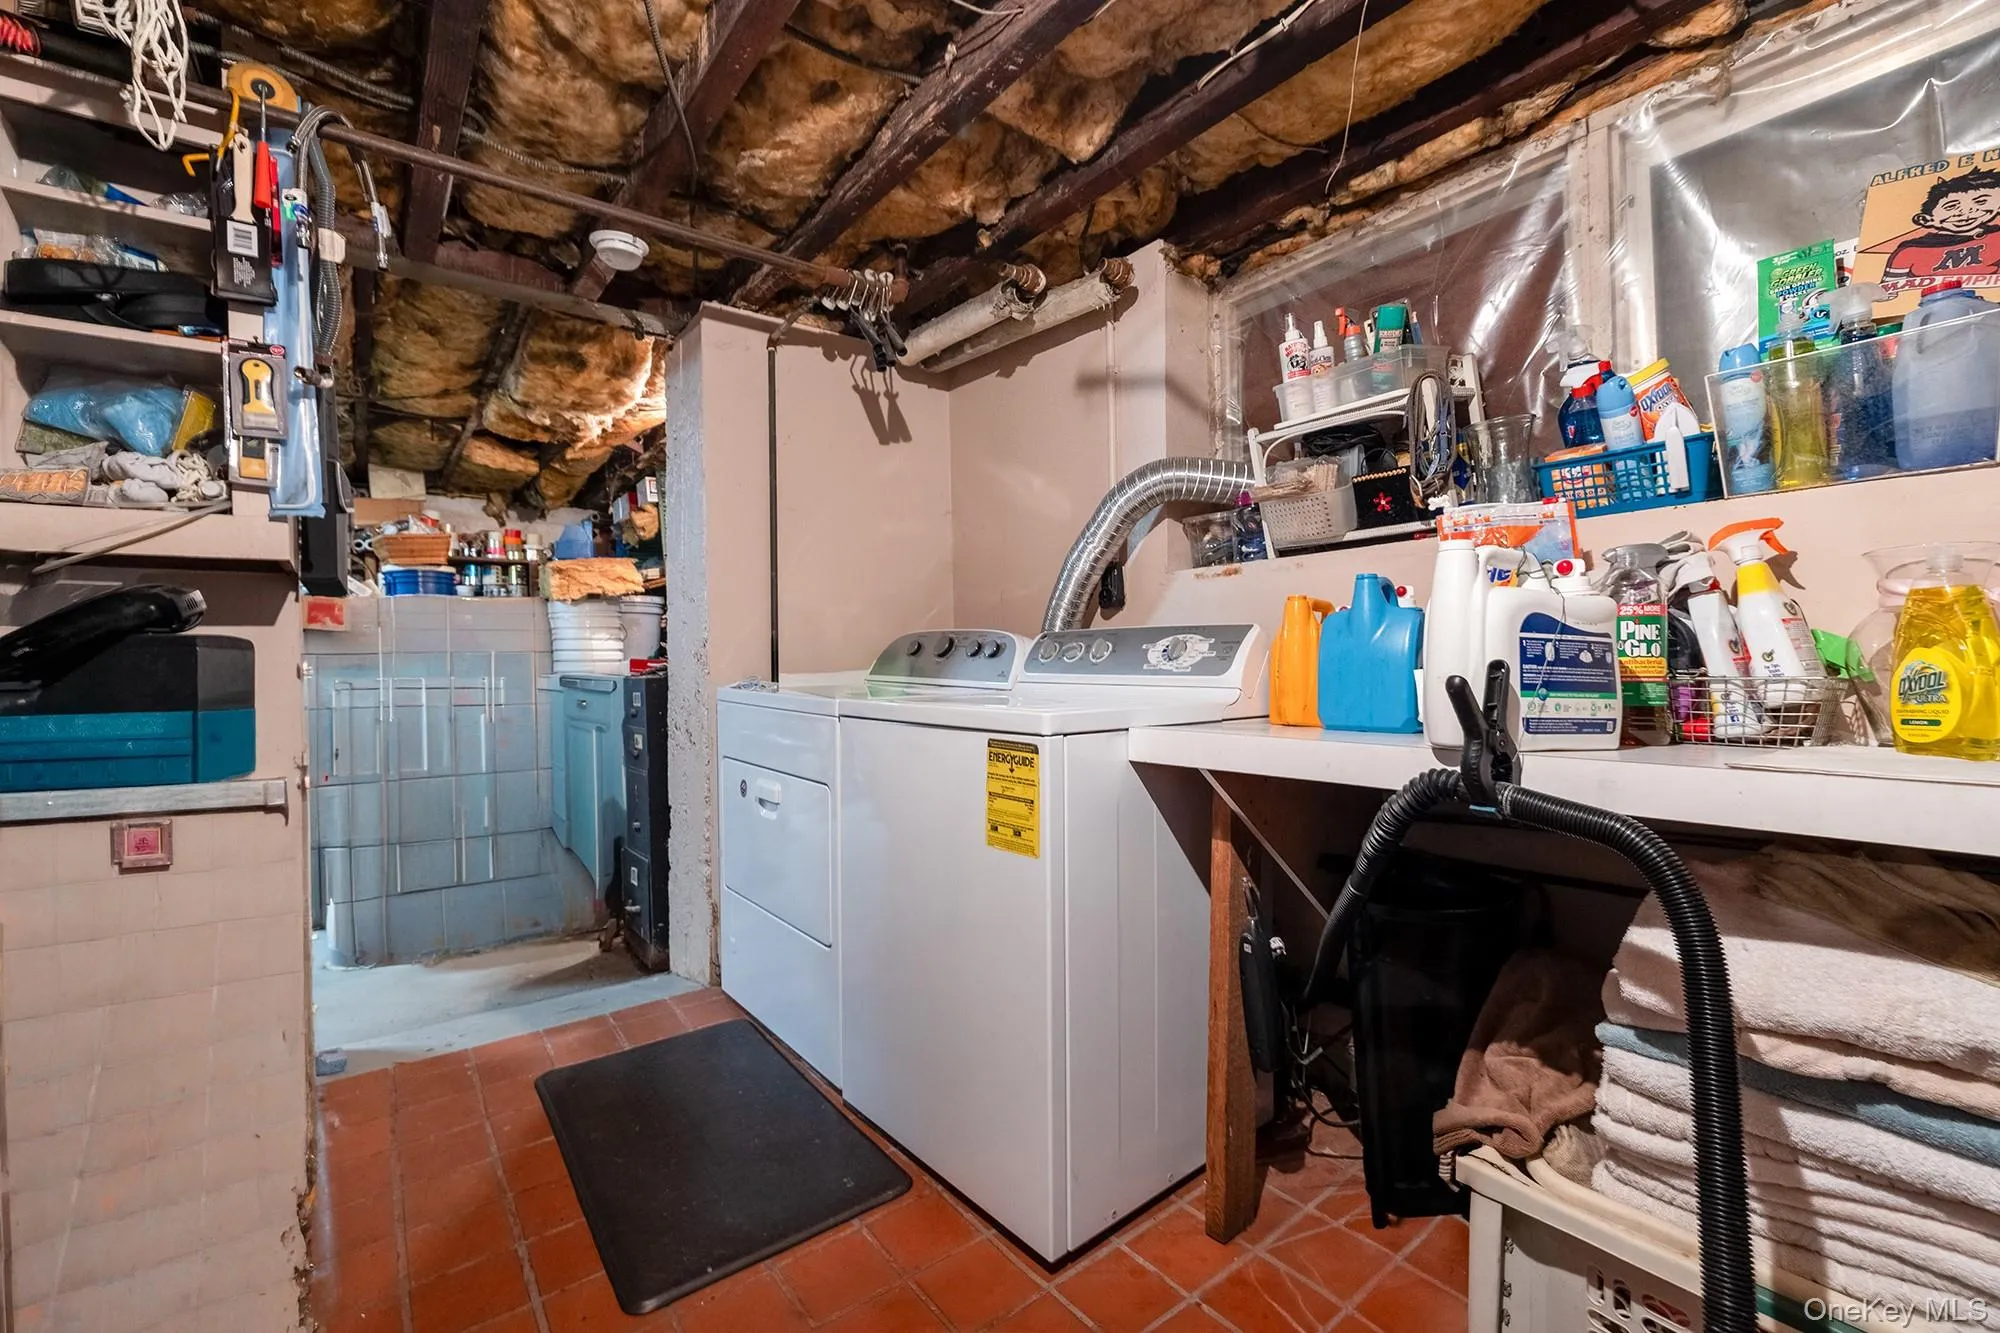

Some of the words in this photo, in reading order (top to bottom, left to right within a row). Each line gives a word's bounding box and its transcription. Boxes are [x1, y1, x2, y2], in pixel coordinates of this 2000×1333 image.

[1871, 160, 1950, 187] ALFRED
[1958, 153, 1975, 167] E
[1932, 244, 1986, 272] M
[1770, 268, 1824, 288] GOBBLER
[1782, 262, 1818, 277] GREEN
[1776, 282, 1816, 298] POWDER
[1881, 277, 1937, 293] MAD
[1619, 605, 1644, 616] 25%
[1620, 620, 1661, 641] PINE
[1898, 671, 1946, 702] OXYDOL
[1917, 695, 1947, 704] ULTRA
